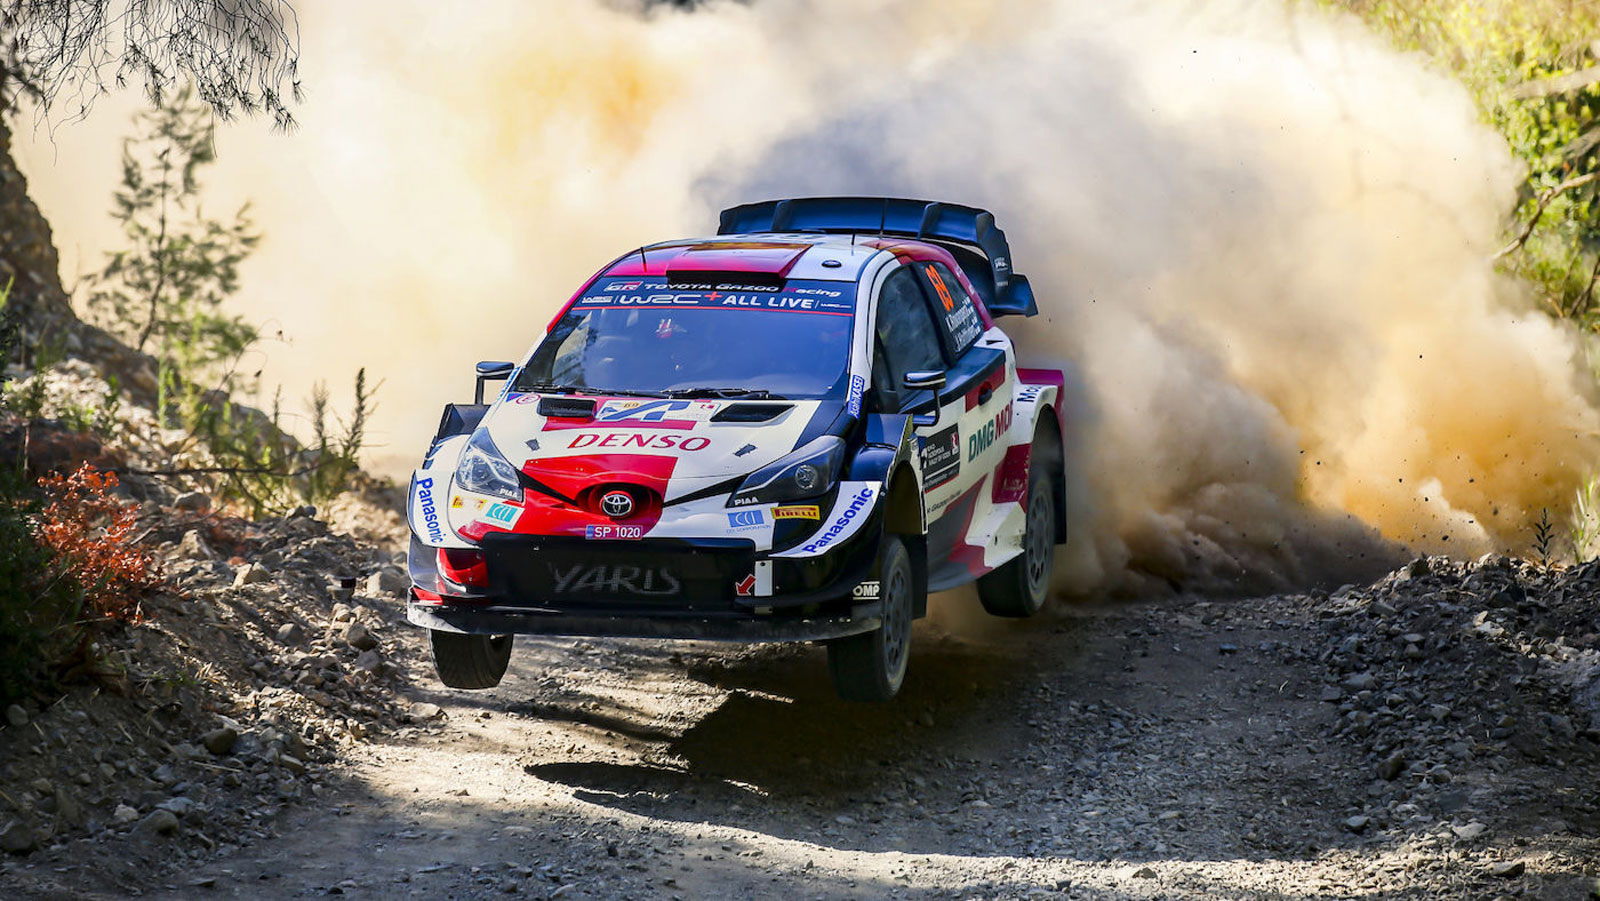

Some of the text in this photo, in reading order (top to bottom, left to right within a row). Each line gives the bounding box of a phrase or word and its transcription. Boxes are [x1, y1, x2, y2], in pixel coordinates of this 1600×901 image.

[715, 284, 779, 292] GAZOO
[783, 287, 842, 297] Racing
[722, 295, 762, 306] ALL
[768, 297, 815, 309] LIVE
[567, 433, 712, 451] DENSO
[968, 419, 995, 463] DMG
[499, 488, 518, 498] PIAA
[734, 496, 759, 506] PIAA
[416, 477, 444, 544] Panasonic
[774, 507, 817, 518] PIRELLI
[803, 487, 874, 553] Panasonic
[594, 527, 641, 538] SP 1020
[551, 563, 681, 595] YARIS
[853, 583, 880, 598] OMP
